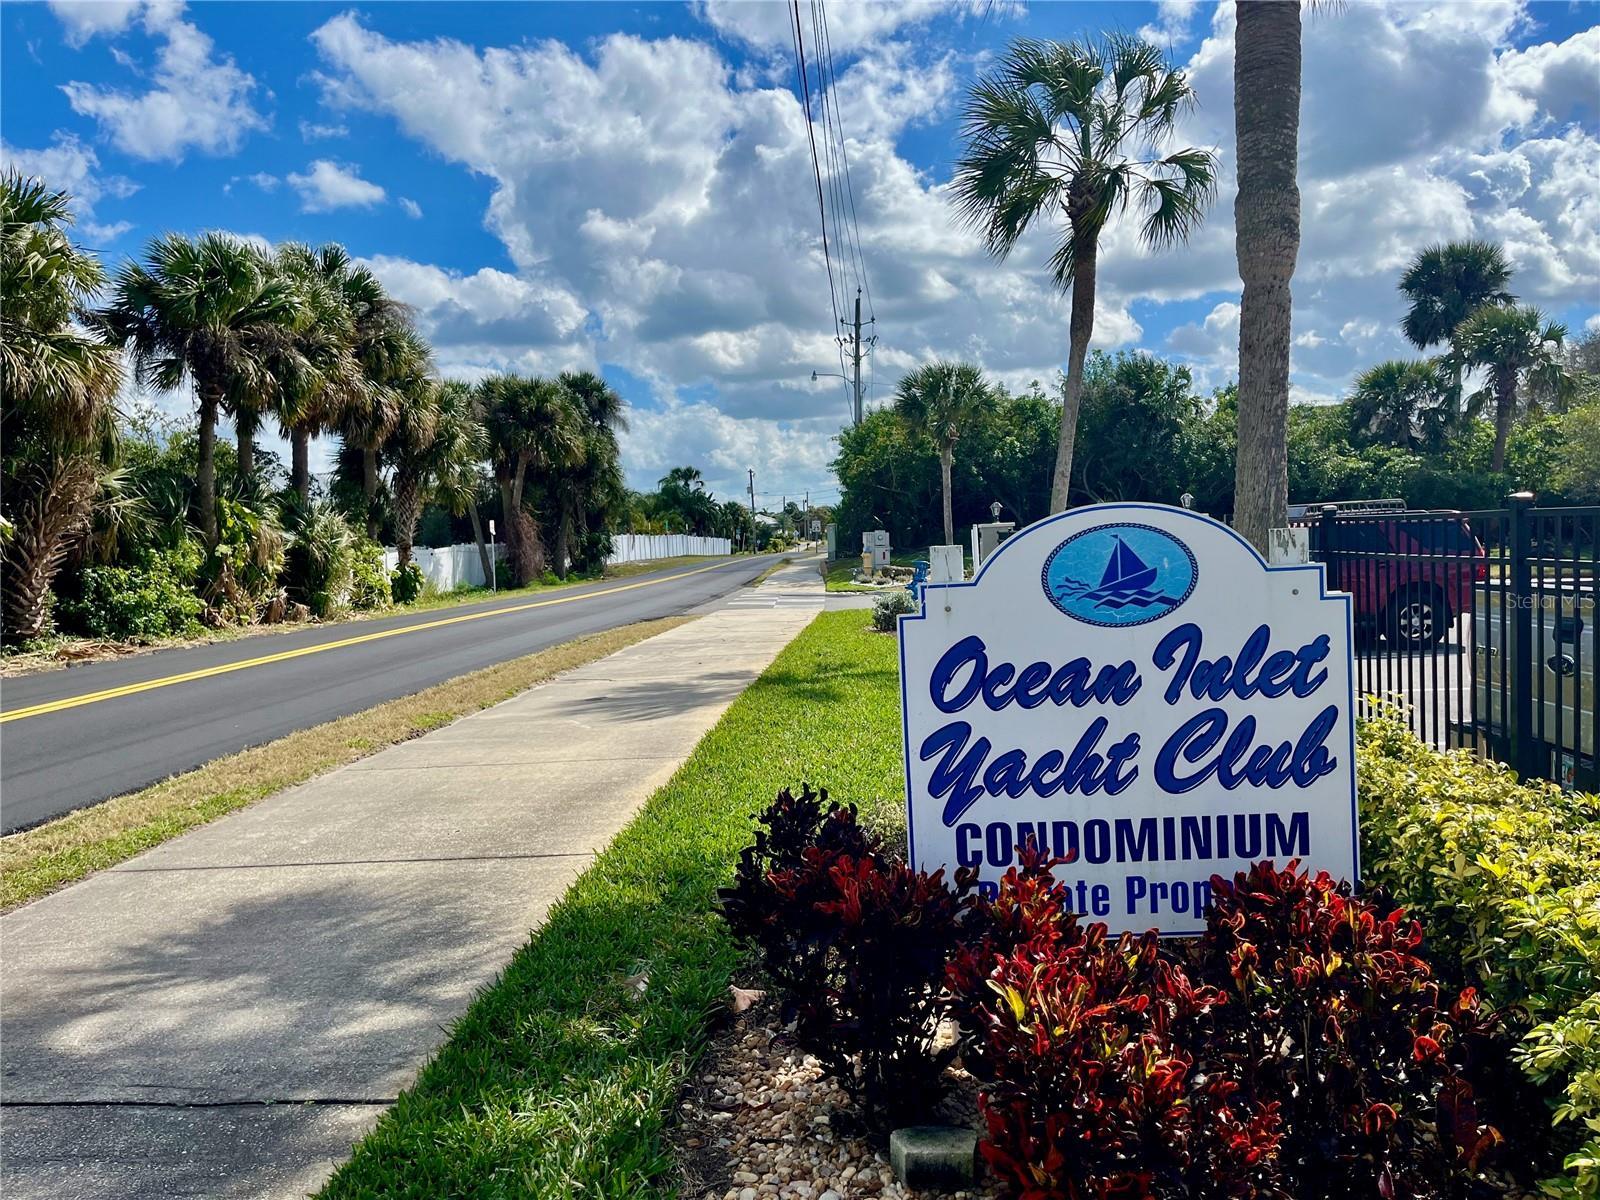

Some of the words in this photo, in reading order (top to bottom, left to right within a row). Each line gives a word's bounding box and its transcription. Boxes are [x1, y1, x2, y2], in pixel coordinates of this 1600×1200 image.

[929, 635, 1142, 713] Ocean
[1152, 623, 1330, 705] Inlet
[920, 716, 1140, 827] Yacht
[1154, 705, 1339, 794] Club
[955, 811, 1311, 868] CONDOMINIUM
